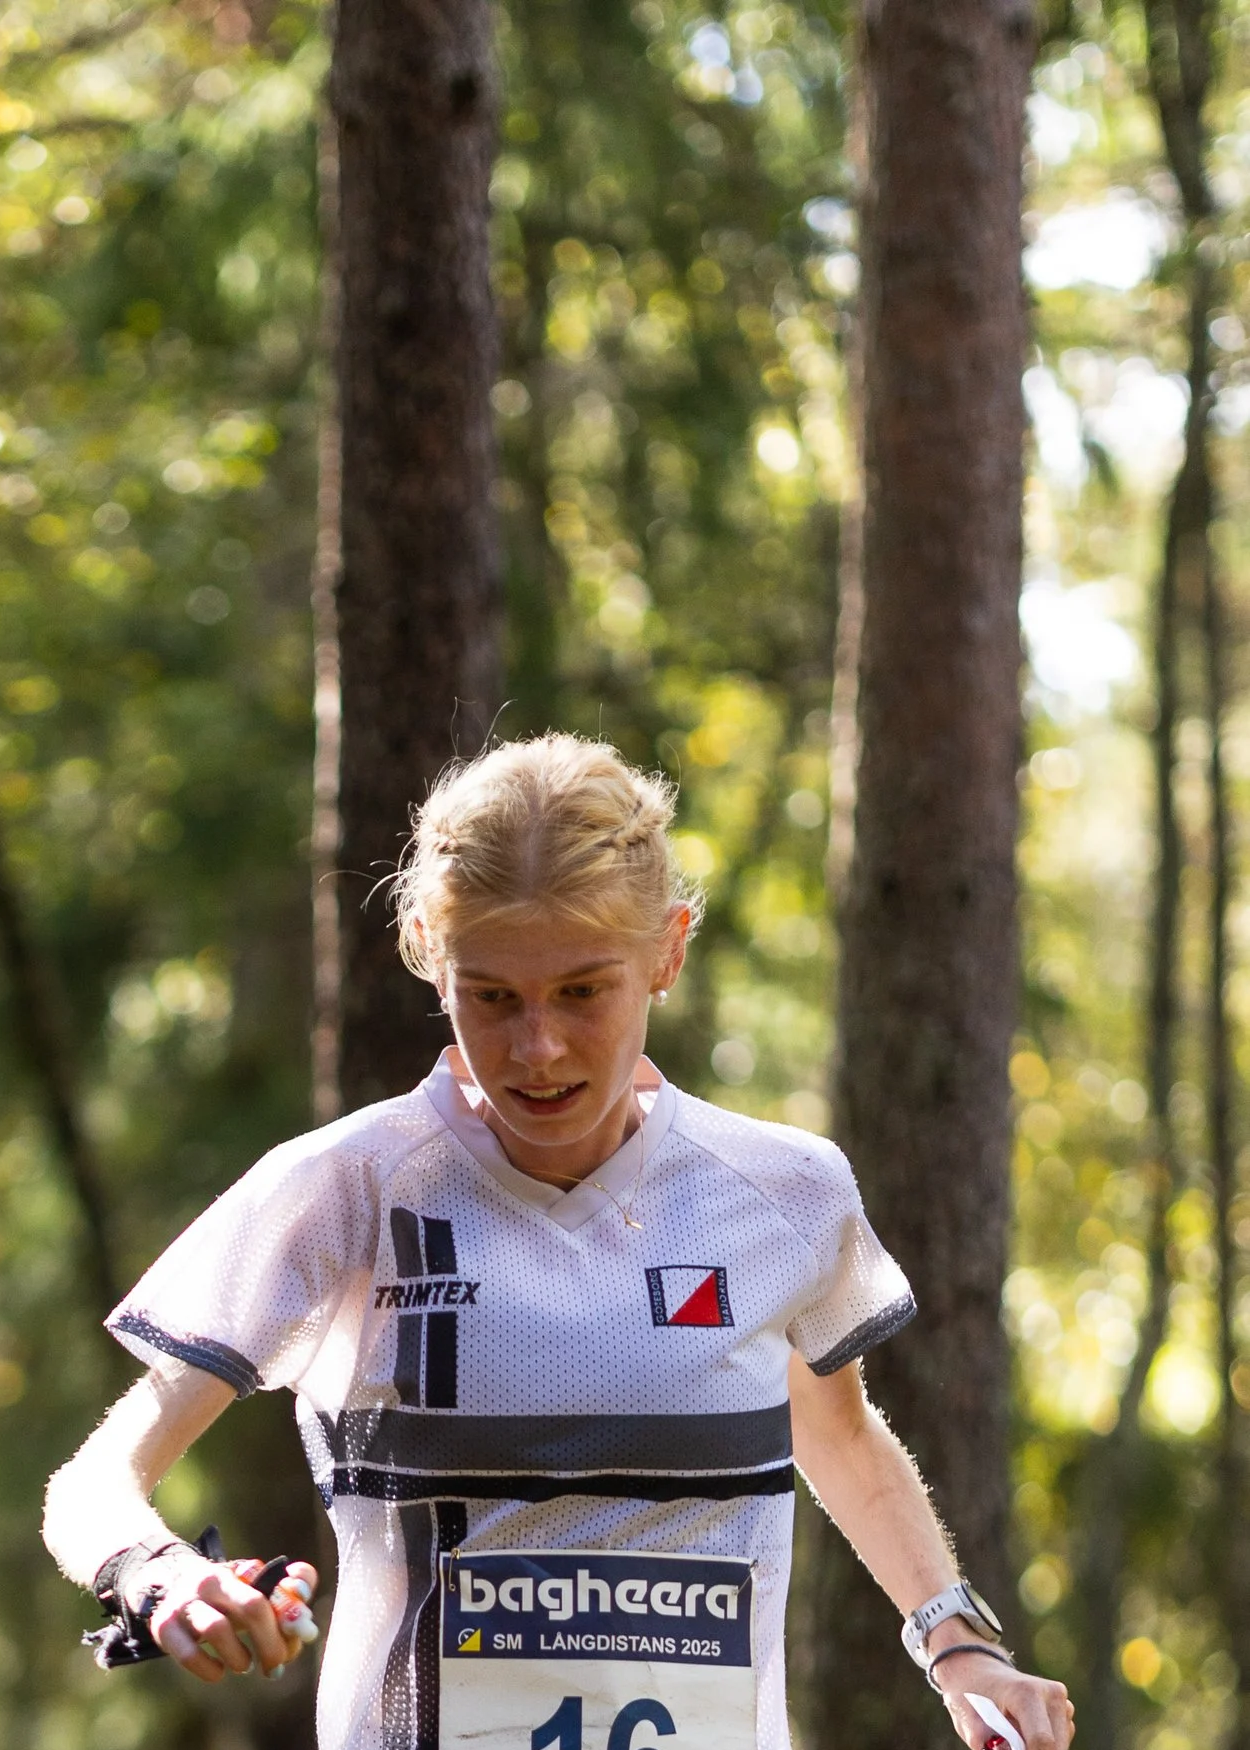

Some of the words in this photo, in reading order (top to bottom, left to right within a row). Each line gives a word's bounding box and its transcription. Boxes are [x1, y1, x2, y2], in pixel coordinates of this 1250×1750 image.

[374, 1280, 481, 1310] TRIMTEX
[717, 1270, 733, 1326] MAJORNA
[459, 1569, 739, 1621] bagheera
[493, 1634, 522, 1650] SM
[540, 1631, 676, 1653] LÅNGDISTANS
[680, 1639, 721, 1657] 2025
